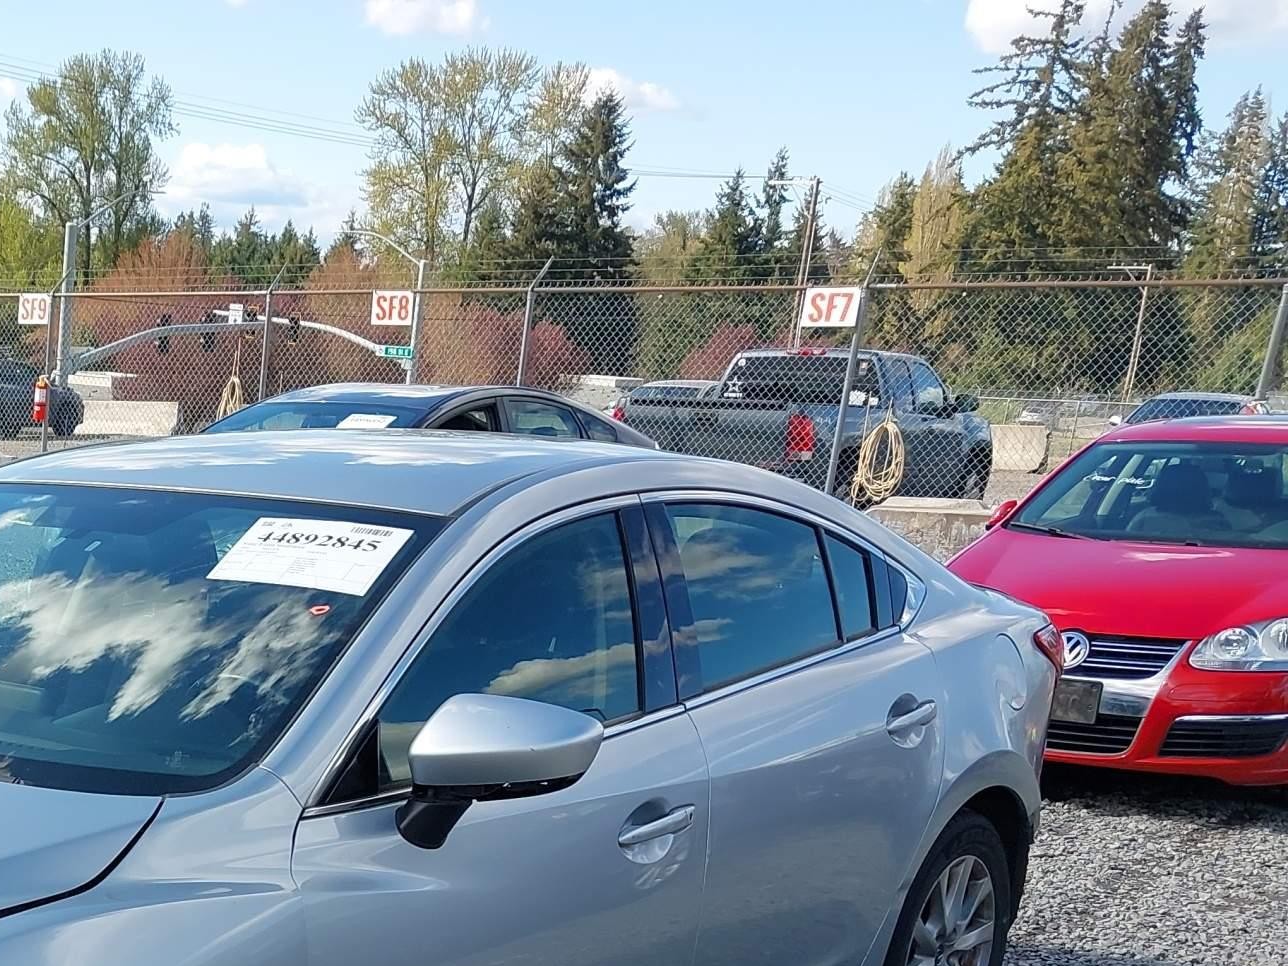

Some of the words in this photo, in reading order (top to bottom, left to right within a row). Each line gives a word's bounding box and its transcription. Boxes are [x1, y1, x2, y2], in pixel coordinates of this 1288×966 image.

[22, 297, 47, 320] SF9
[376, 295, 410, 321] SF8
[808, 292, 854, 322] SF7
[257, 531, 382, 553] 44892845
